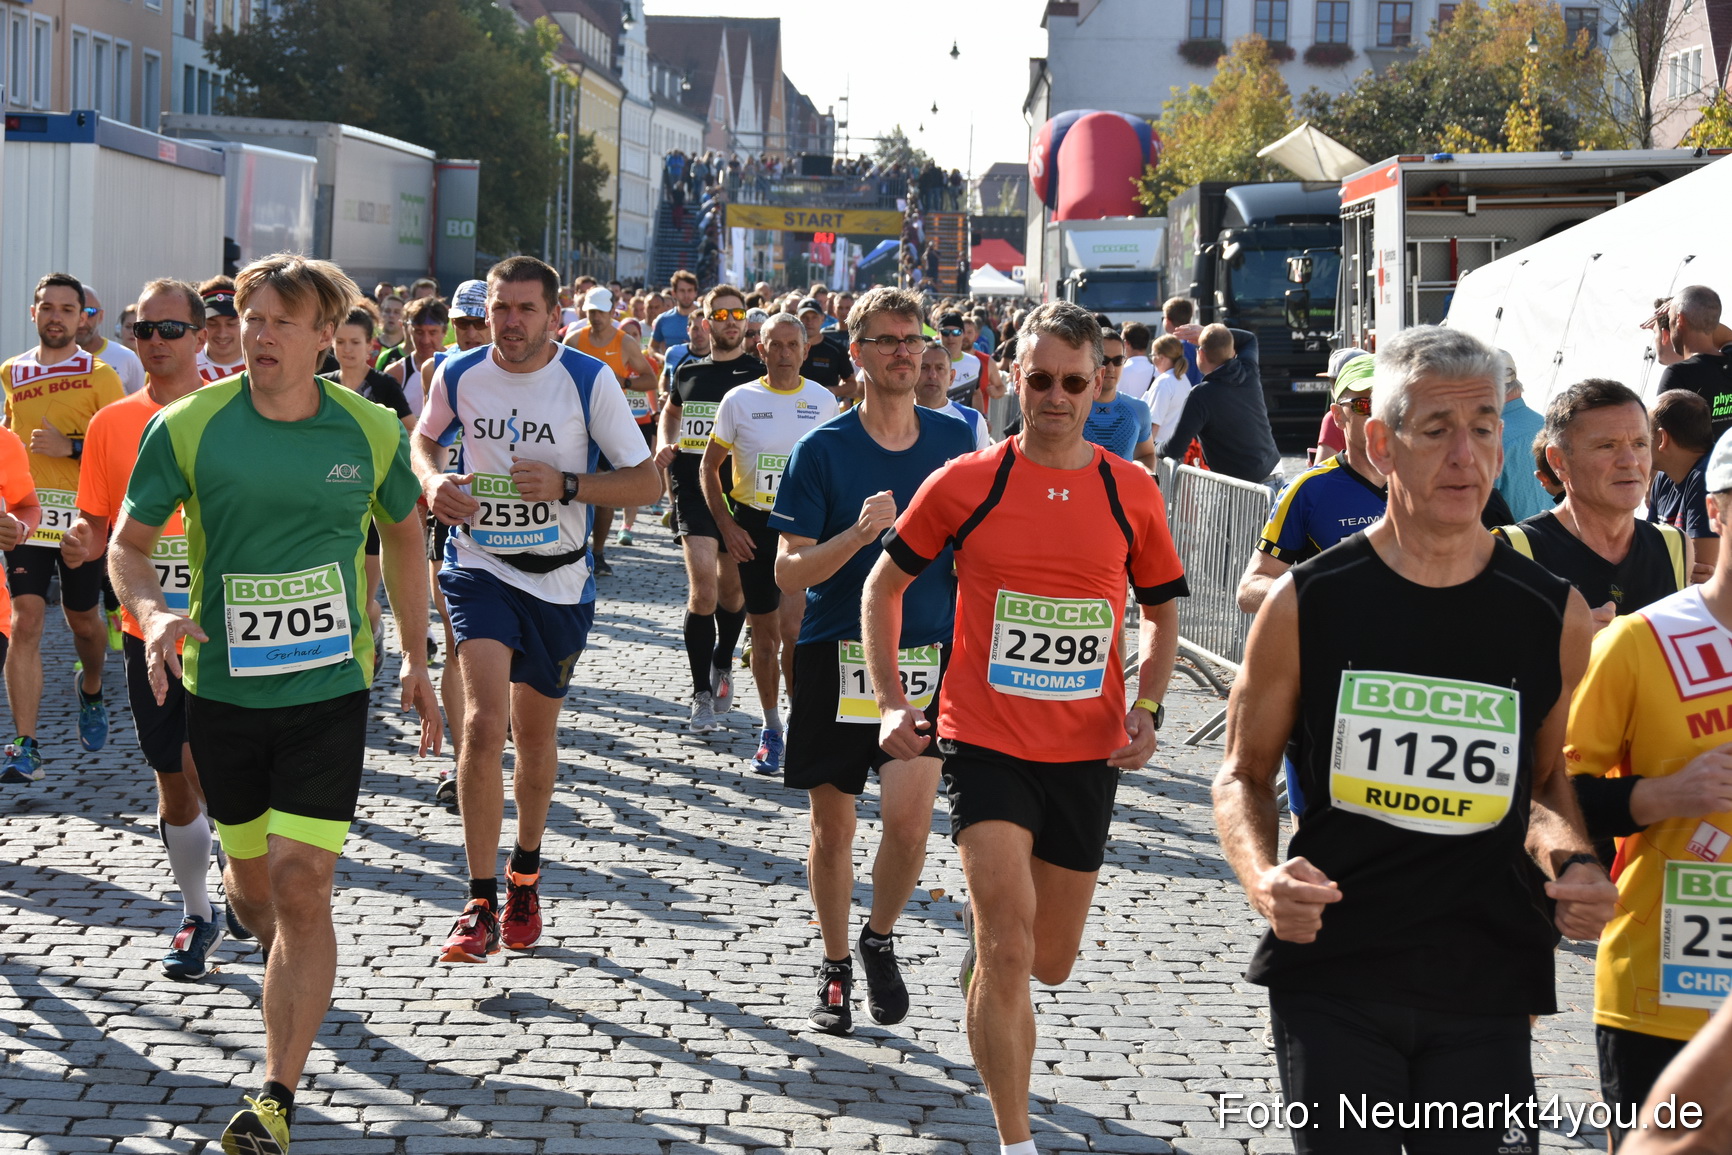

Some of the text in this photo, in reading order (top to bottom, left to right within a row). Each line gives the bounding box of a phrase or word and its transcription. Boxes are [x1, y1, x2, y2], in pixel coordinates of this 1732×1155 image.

[446, 218, 476, 238] BO
[784, 211, 844, 228] START
[13, 378, 93, 404] MAX BÖGL
[685, 404, 720, 416] BOC
[474, 409, 556, 451] SUSPA
[326, 464, 361, 479] AOK
[479, 502, 549, 527] 2530
[1338, 515, 1380, 526] TEAM
[32, 531, 65, 540] THIA
[486, 533, 544, 545] JOHANN
[155, 565, 191, 588] 75
[232, 570, 334, 601] BOCK
[239, 602, 334, 641] 2705
[1004, 596, 1105, 626] BOCK
[266, 645, 321, 661] Gerhard
[1005, 629, 1099, 665] 2298
[853, 669, 928, 696] 15
[1011, 671, 1086, 689] THOMAS
[1352, 677, 1505, 728] BOCK
[1358, 727, 1496, 784] 1126
[1502, 746, 1510, 754] B
[1365, 787, 1473, 817] RUDOLF
[1498, 1145, 1532, 1154] odlo
